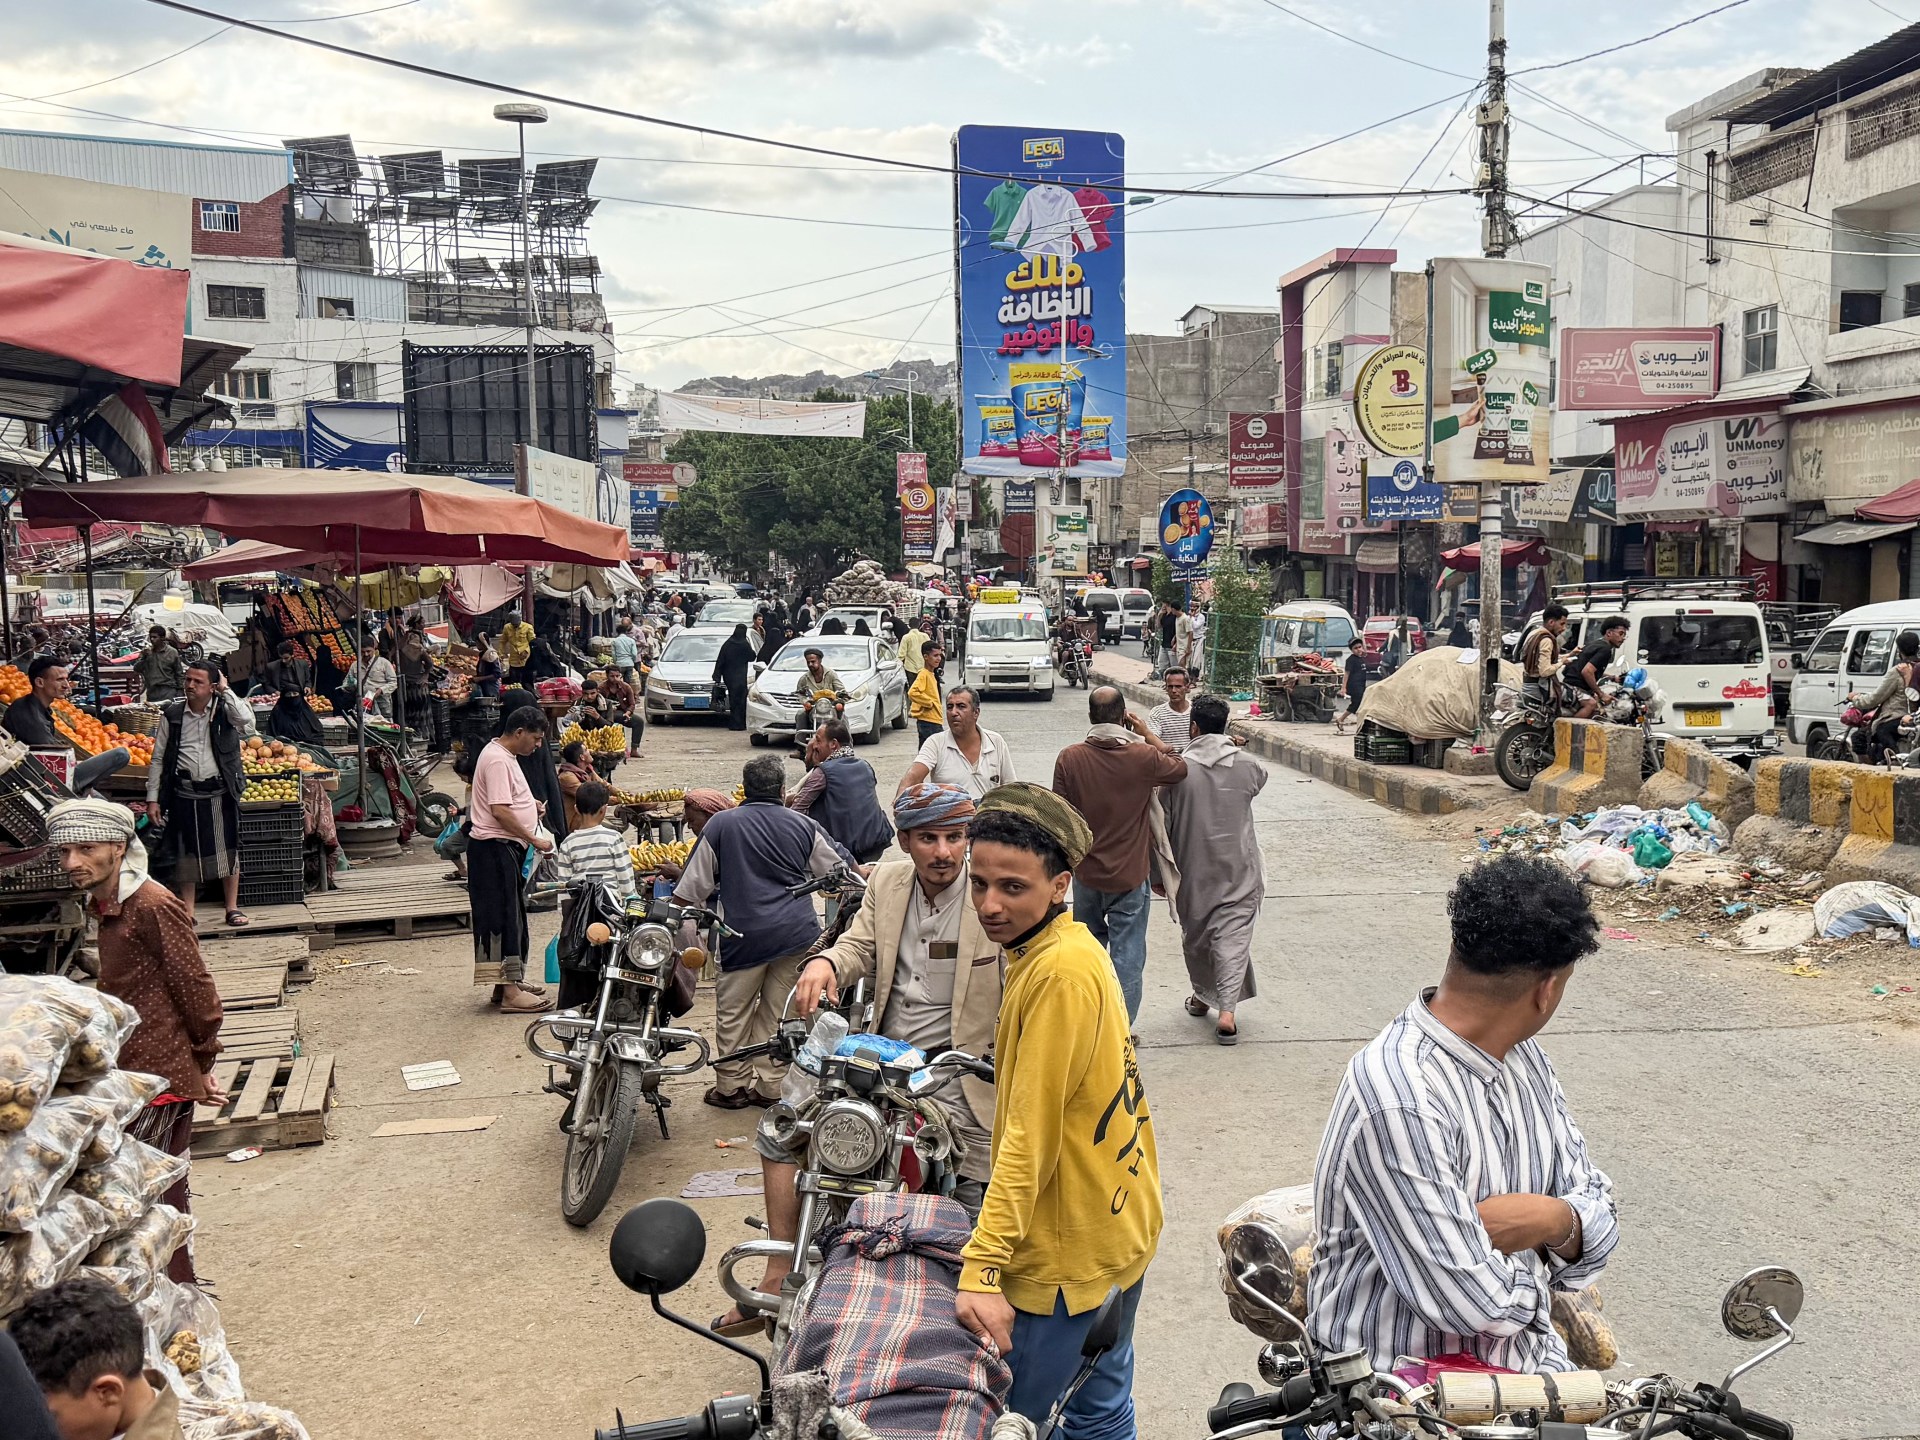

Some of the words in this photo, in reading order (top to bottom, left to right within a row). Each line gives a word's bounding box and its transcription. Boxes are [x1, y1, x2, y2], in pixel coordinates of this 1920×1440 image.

[1025, 140, 1062, 157] LEGA
[70, 220, 88, 229] نقي
[89, 223, 118, 233] طبيعي
[120, 226, 134, 235] ماء
[1005, 254, 1083, 290] ملك
[998, 286, 1092, 324] النظافة
[1513, 306, 1536, 321] عبوات
[1492, 317, 1519, 334] الجديدة
[997, 318, 1094, 355] والتوفير
[1653, 347, 1709, 366] الأيوبي
[1641, 370, 1679, 378] والتحويلات
[1655, 382, 1694, 390] 04-250895
[1240, 441, 1274, 450] مجموعة
[1670, 428, 1709, 459] الأيوبي
[1726, 438, 1785, 453] UNMoney
[1231, 452, 1256, 461] التجارية
[1671, 458, 1709, 471] للصرافة
[1620, 467, 1655, 484] UNMoney
[1671, 471, 1711, 484] والتحويلات
[1725, 467, 1783, 492] الأيوبي
[1676, 487, 1705, 497] 04-250895
[1726, 491, 1778, 505] والتحويلات
